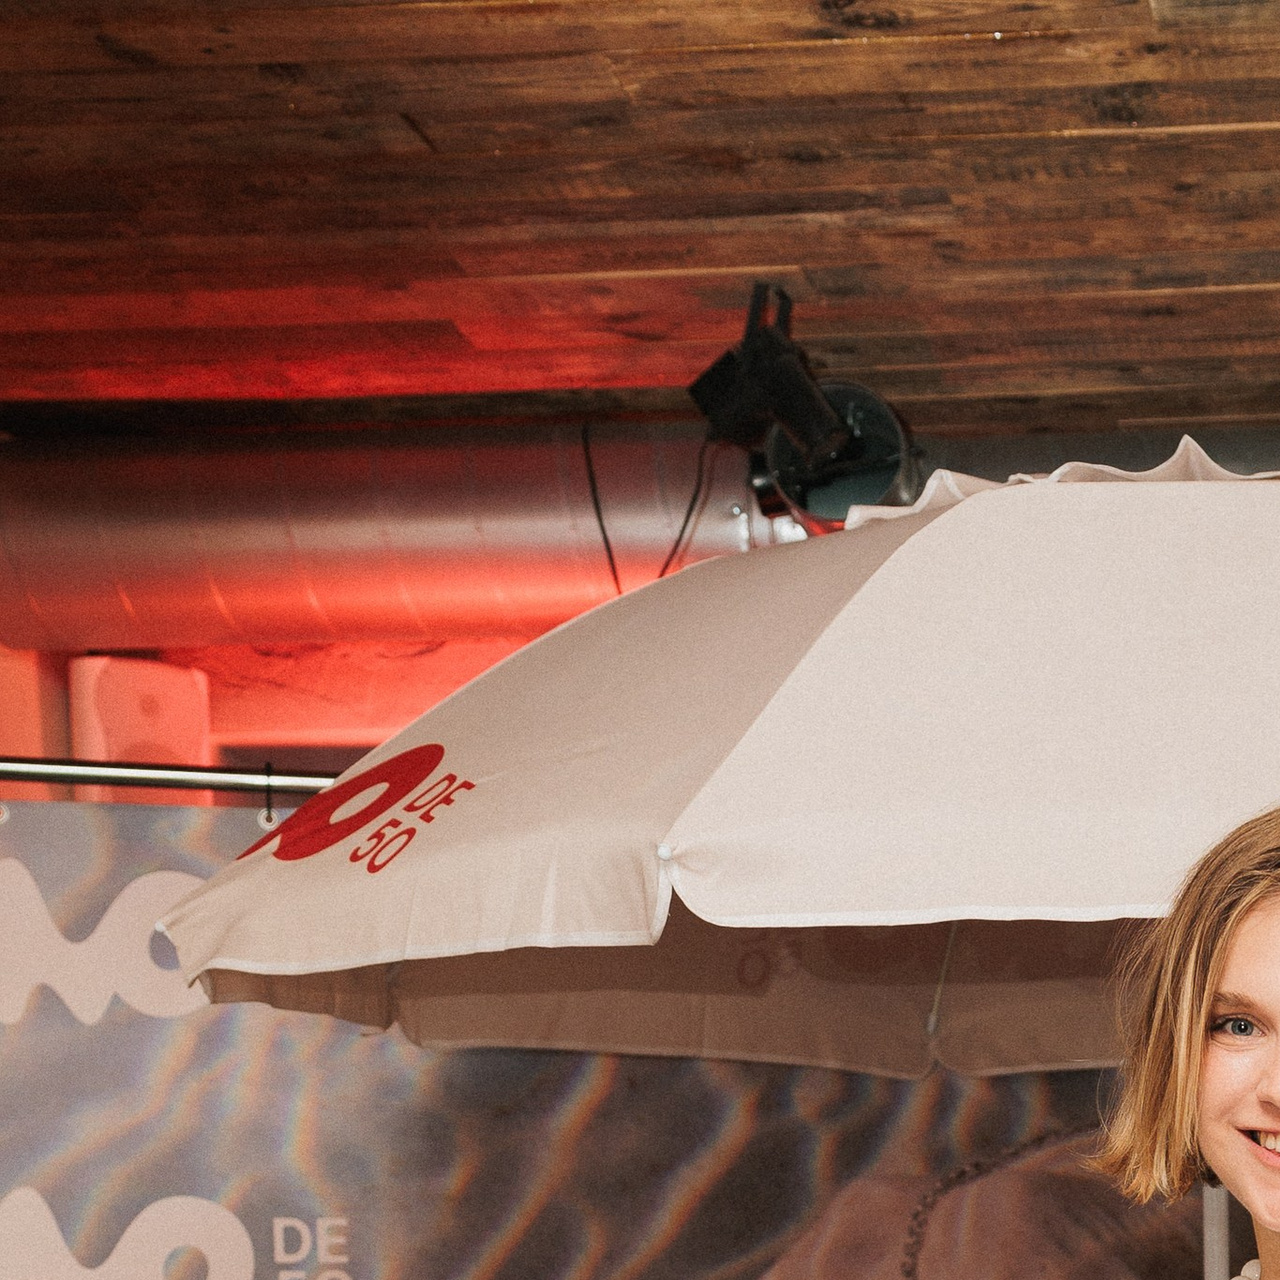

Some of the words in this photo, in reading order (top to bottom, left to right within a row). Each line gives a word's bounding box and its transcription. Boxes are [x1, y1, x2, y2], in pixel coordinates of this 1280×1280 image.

[402, 773, 476, 824] DE
[349, 818, 417, 874] 50
[273, 1217, 350, 1265] DE
